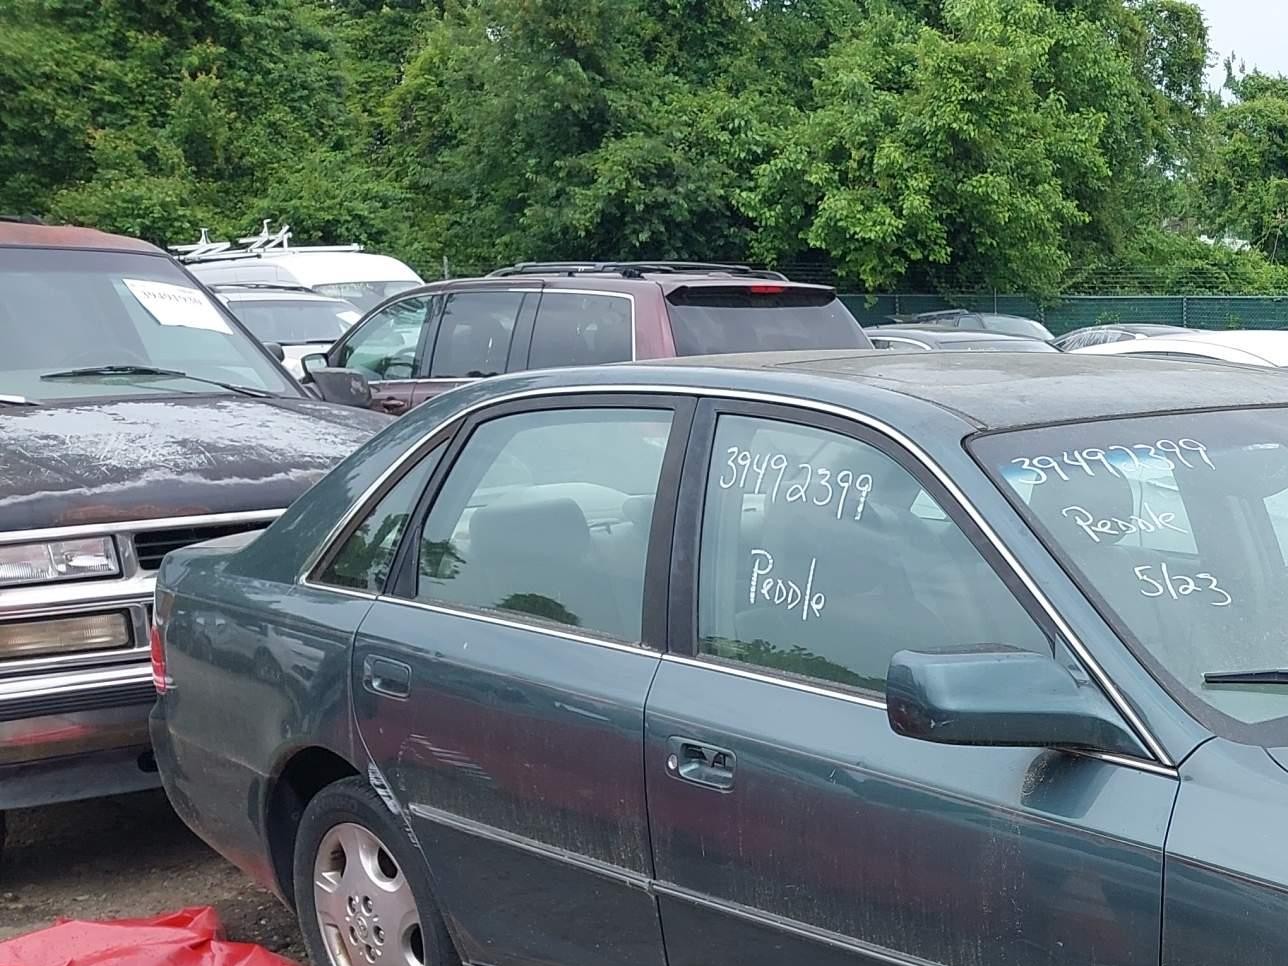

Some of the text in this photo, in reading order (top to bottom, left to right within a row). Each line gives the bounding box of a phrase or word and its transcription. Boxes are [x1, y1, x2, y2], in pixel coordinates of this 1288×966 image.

[719, 447, 873, 521] 39492399
[1011, 438, 1216, 485] 39492399
[1133, 562, 1233, 606] 5/23
